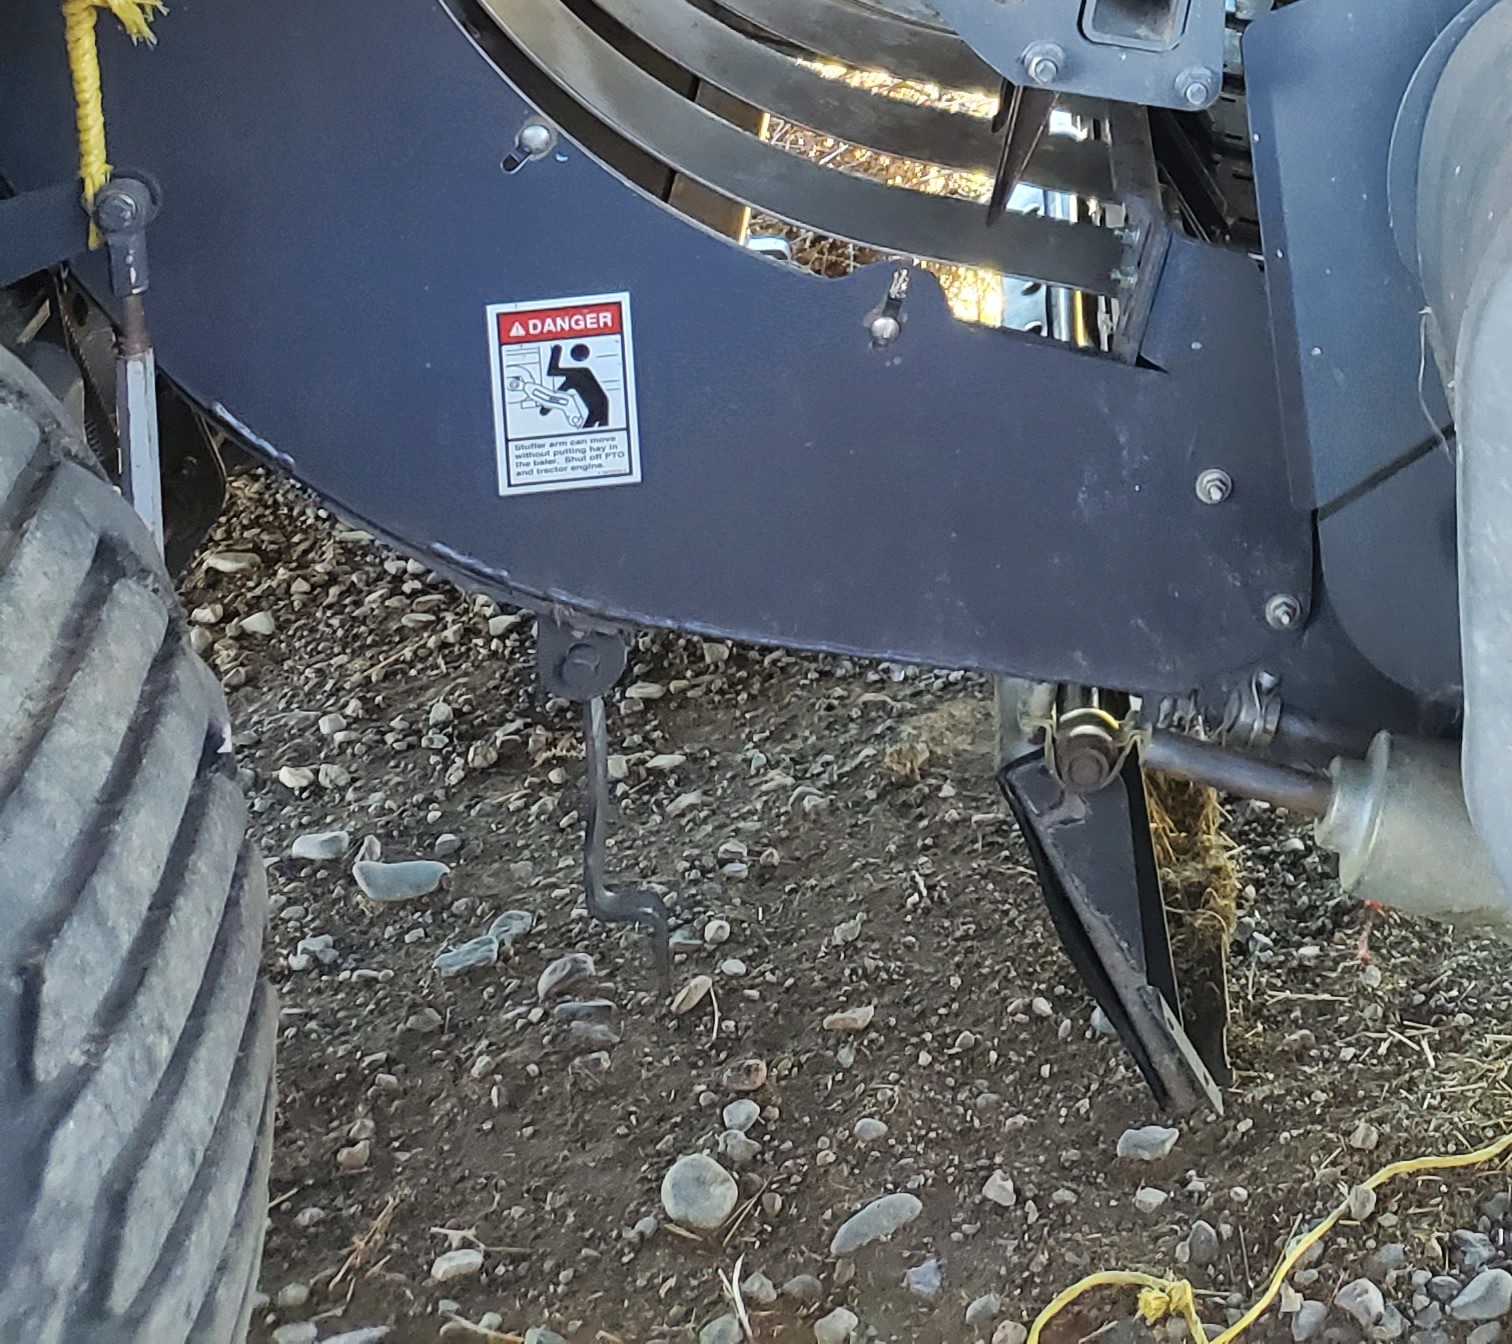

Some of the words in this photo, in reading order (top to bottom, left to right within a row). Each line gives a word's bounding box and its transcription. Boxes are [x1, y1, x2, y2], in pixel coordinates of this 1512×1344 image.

[527, 311, 613, 335] DANGER
[590, 436, 617, 444] move
[514, 450, 550, 459] without
[553, 447, 588, 457] putting
[589, 445, 606, 453] hay
[515, 460, 531, 468] the
[565, 455, 587, 463] Shut
[589, 453, 602, 461] off
[605, 451, 625, 460] PTO
[537, 466, 569, 474] tractor
